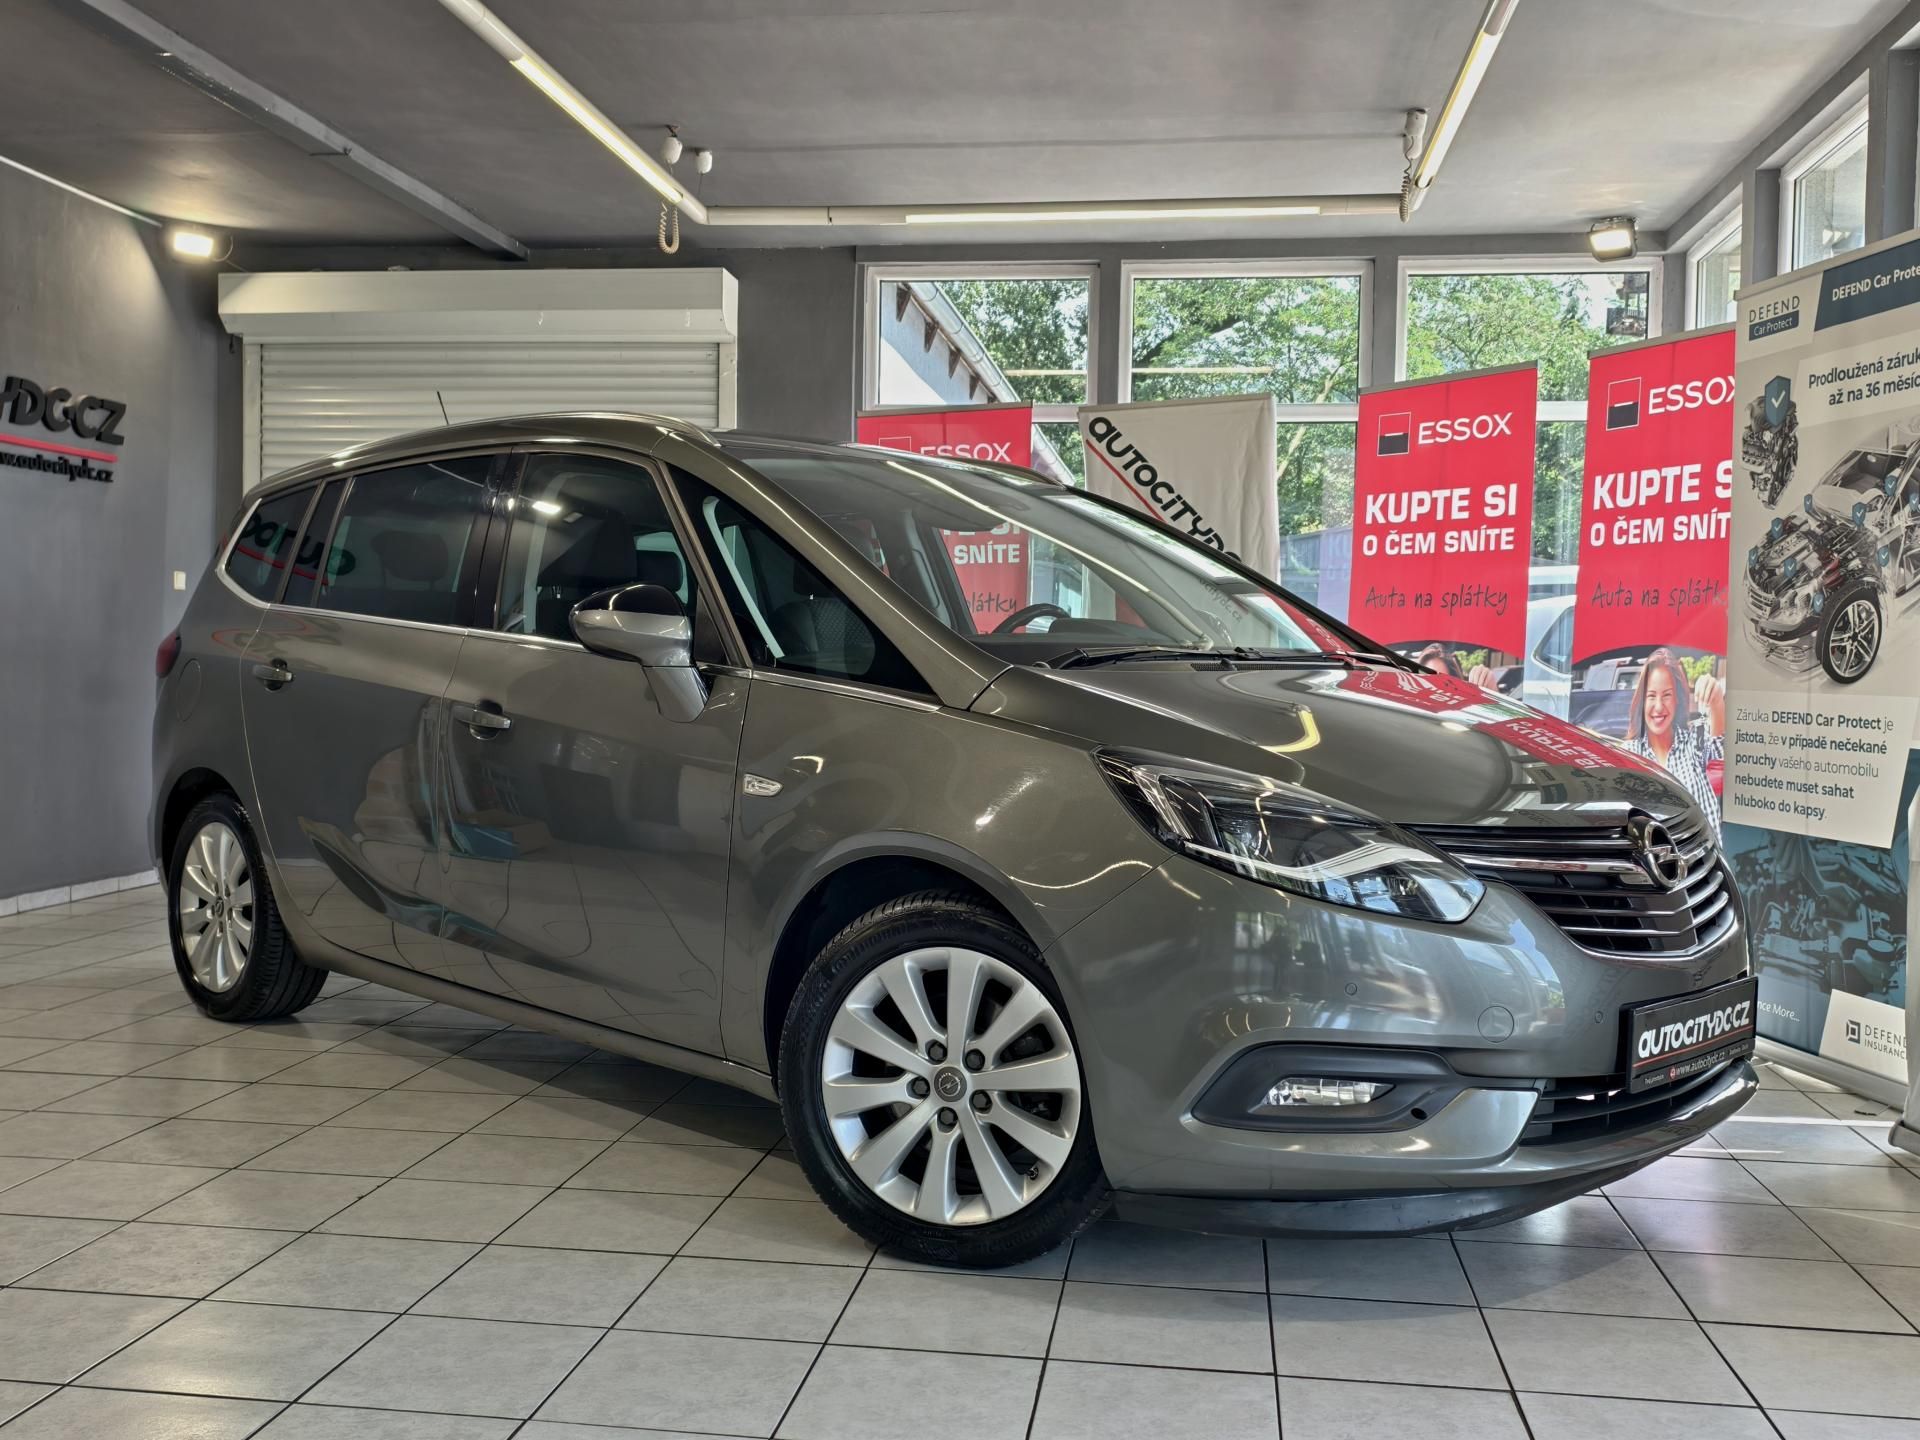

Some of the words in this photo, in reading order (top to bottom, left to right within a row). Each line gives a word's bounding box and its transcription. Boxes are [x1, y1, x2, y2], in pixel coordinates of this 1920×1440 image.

[1832, 278, 1872, 302] DEFEND
[1873, 274, 1891, 289] Car
[1893, 264, 1920, 283] Prote
[1749, 295, 1800, 323] DEFEND
[1753, 325, 1766, 336] Car
[1766, 317, 1793, 332] Protect
[1808, 356, 1884, 389] Prodloužená
[1886, 347, 1920, 371] záruk
[1828, 388, 1844, 406] až
[1847, 388, 1863, 403] na
[1865, 380, 1881, 398] 36
[1883, 372, 1920, 394] měsíc
[1418, 412, 1513, 445] ESSOX
[1593, 464, 1702, 511] KUPTE
[1715, 459, 1733, 500] S
[1365, 487, 1471, 525] KUPTE
[1484, 483, 1518, 518] SI
[1362, 535, 1378, 556] O
[1385, 528, 1436, 556] ČEM
[1444, 524, 1515, 554] SNÍTE
[1590, 522, 1606, 547] O
[1612, 515, 1664, 546] ČEM
[1672, 507, 1732, 541] SNÍT
[953, 540, 1021, 565] SNÍTE
[1364, 584, 1405, 609] Auta
[1415, 590, 1433, 608] na
[1440, 583, 1509, 617] splátky
[1592, 581, 1633, 608] Auta
[1641, 587, 1660, 607] na
[1736, 708, 1769, 723] Záruka
[1771, 710, 1814, 726] DEFEND
[1815, 713, 1834, 728] Car
[1837, 714, 1882, 730] Protect
[1882, 717, 1894, 734] je
[1735, 729, 1767, 745] jistota,
[1768, 732, 1780, 745] že
[1780, 735, 1788, 746] v
[1788, 734, 1827, 751] případě
[1829, 738, 1888, 755] nečekané
[1735, 752, 1777, 769] poruchy
[1778, 756, 1812, 771] vašeho
[1813, 762, 1879, 778] automobilu
[1734, 773, 1784, 790] nebudete
[1786, 780, 1819, 795] muset
[1821, 784, 1855, 799] sahat
[1734, 793, 1776, 811] hluboko
[1777, 800, 1791, 813] do
[1864, 1038, 1905, 1060] INSURANC
